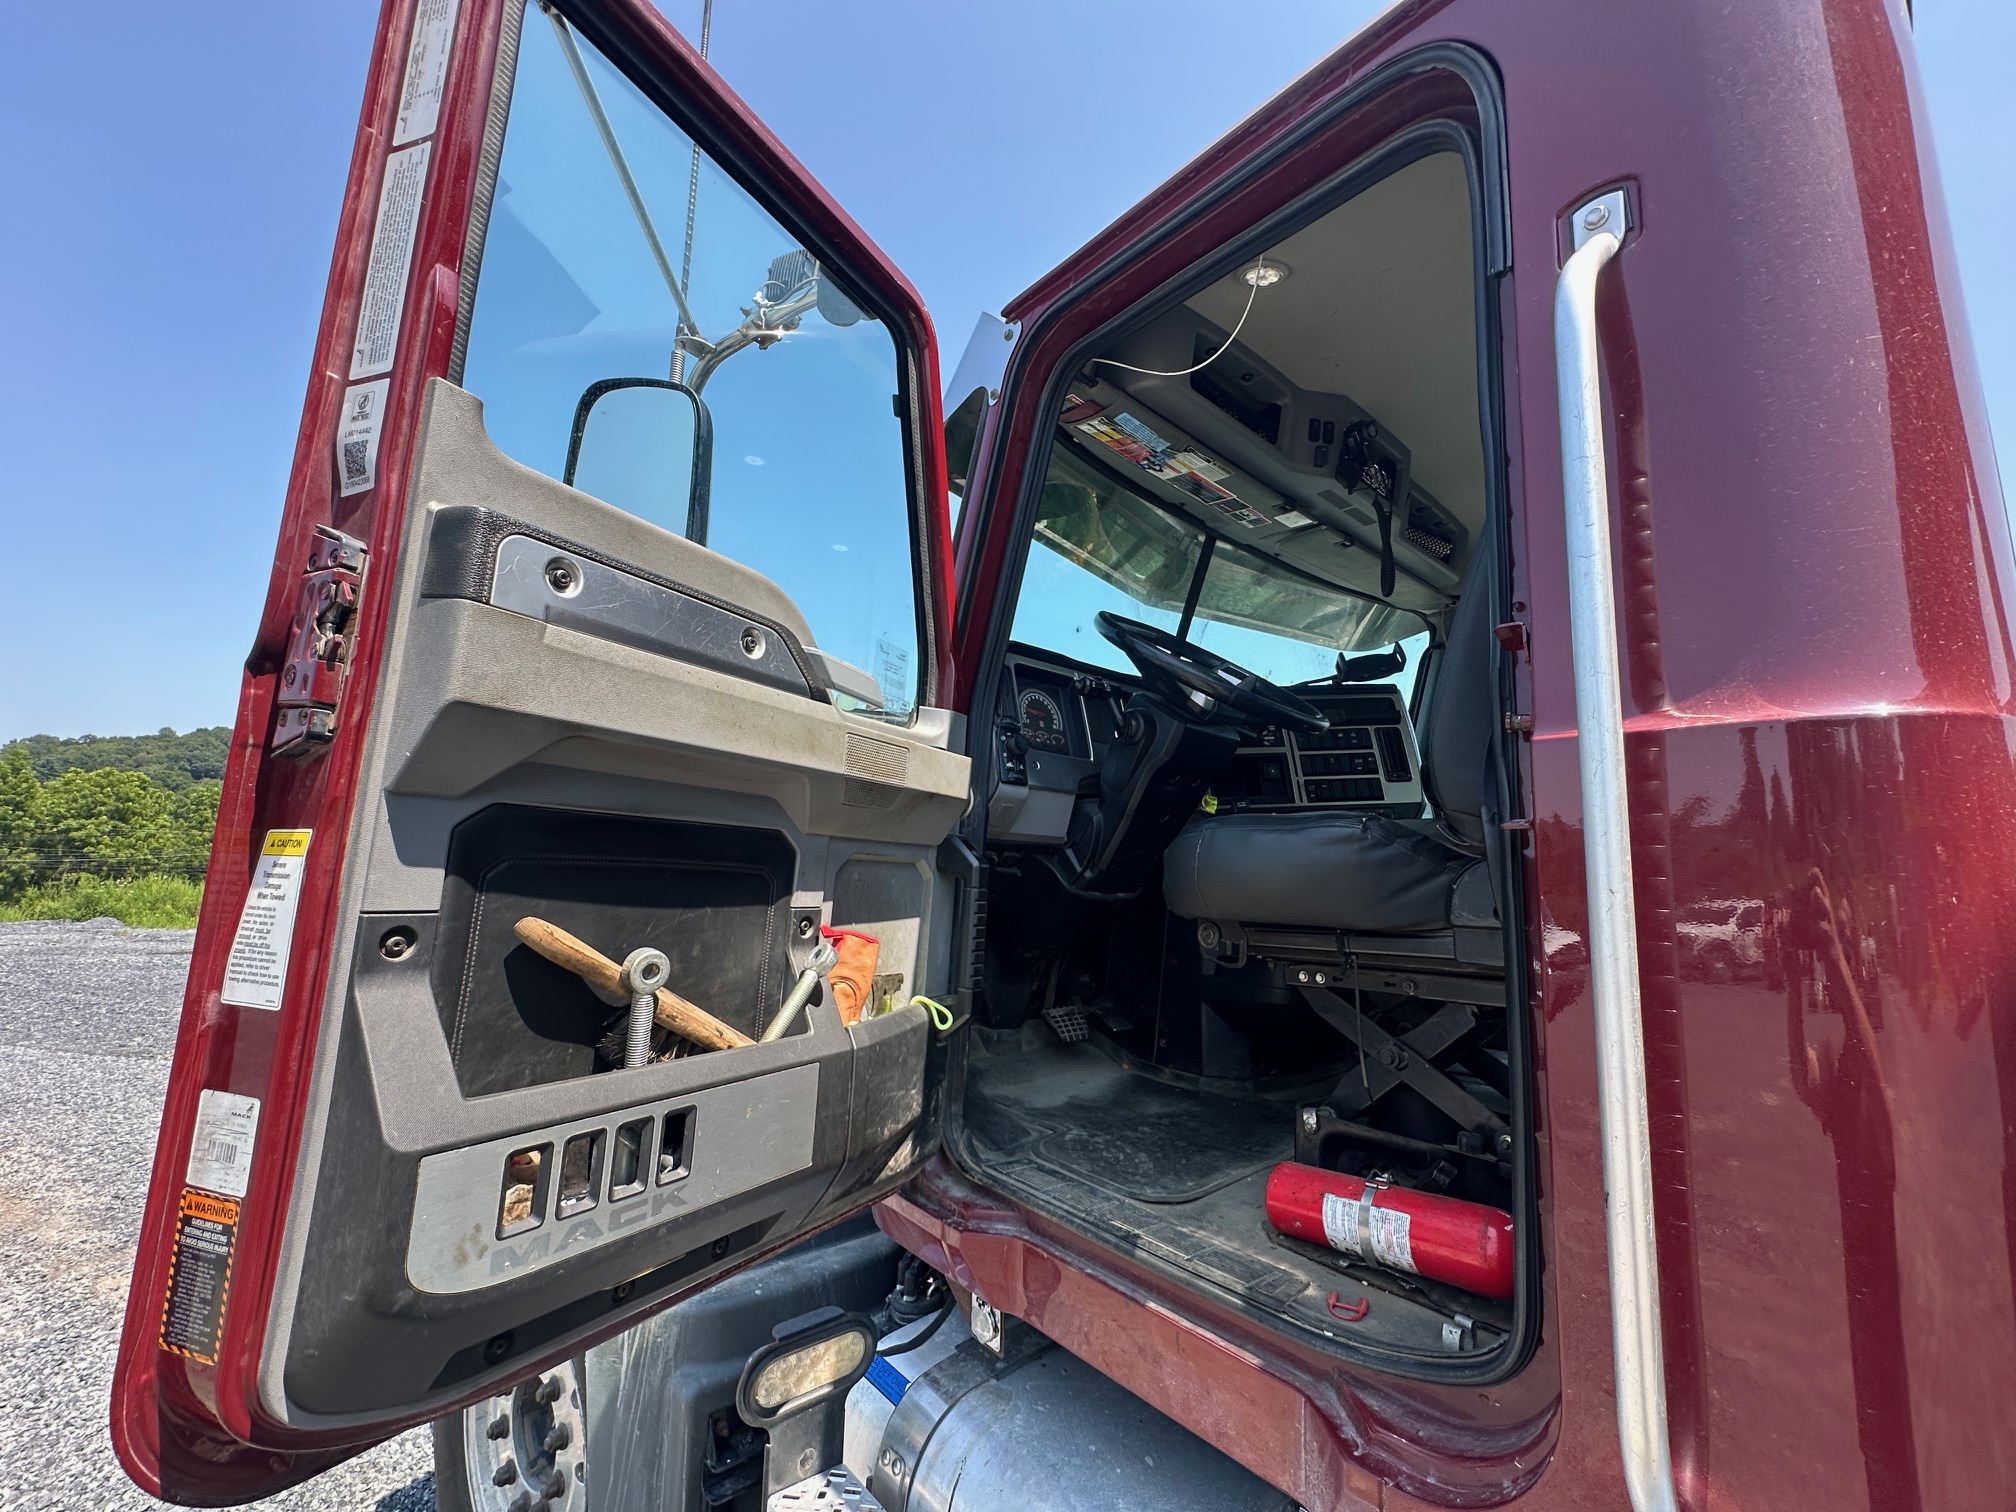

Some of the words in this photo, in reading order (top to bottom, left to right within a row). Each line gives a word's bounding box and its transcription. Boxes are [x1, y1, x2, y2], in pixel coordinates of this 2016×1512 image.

[276, 839, 302, 848] CAUTION
[263, 871, 290, 879] Transmission
[264, 882, 282, 891] Damage
[194, 1201, 234, 1219] WARNING
[192, 1218, 214, 1229] GUIDELINES
[214, 1223, 223, 1231] FOR
[488, 1184, 689, 1277] MACK
[184, 1226, 202, 1237] ENTERING
[203, 1230, 211, 1238] AND
[212, 1232, 227, 1242] EXITING
[186, 1237, 197, 1246] AVOID
[197, 1239, 214, 1249] SERIOUS
[214, 1243, 229, 1253] INJURY
[879, 1366, 893, 1378] DEF
[892, 1377, 904, 1392] ONL
